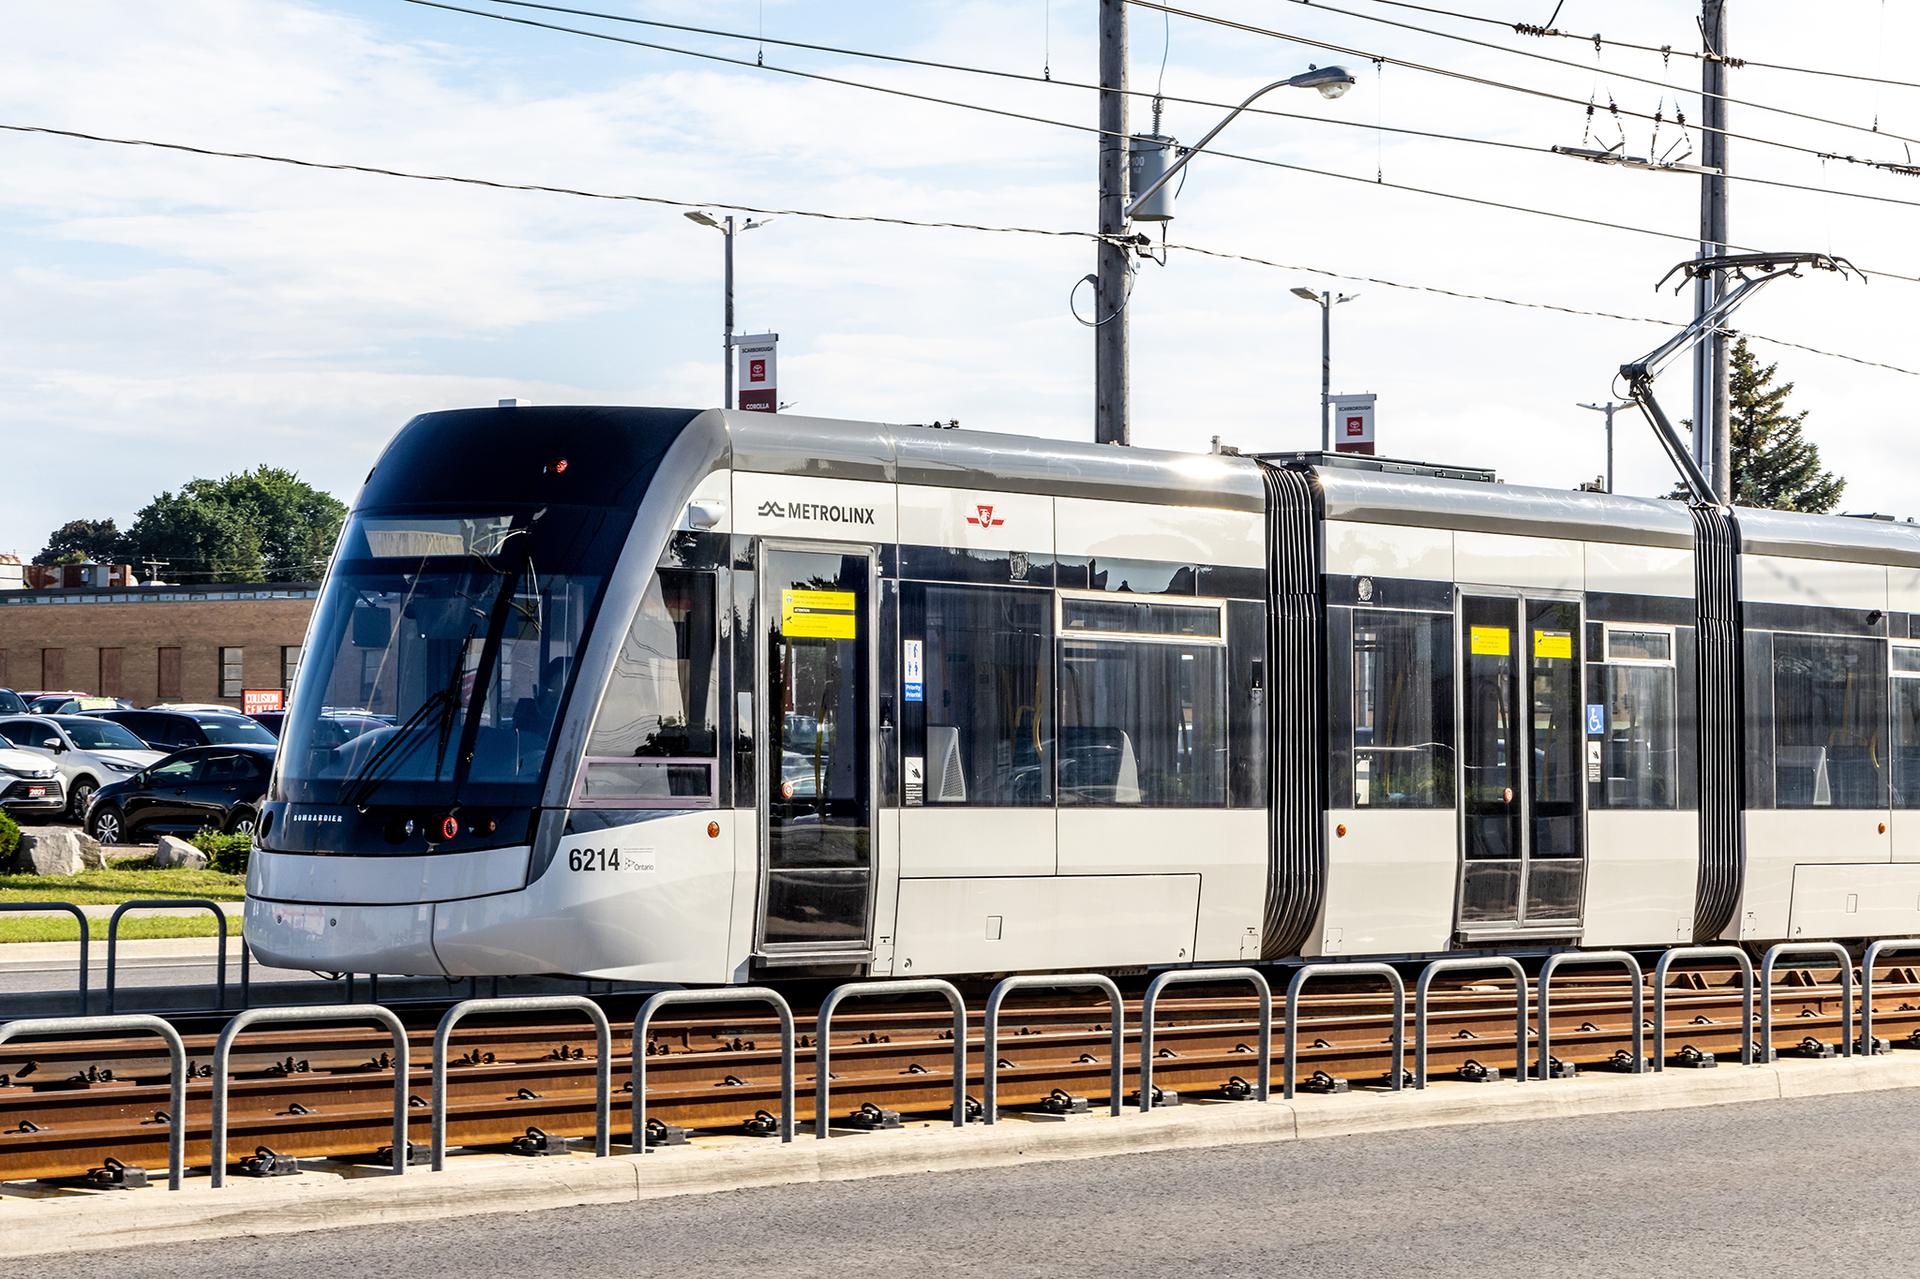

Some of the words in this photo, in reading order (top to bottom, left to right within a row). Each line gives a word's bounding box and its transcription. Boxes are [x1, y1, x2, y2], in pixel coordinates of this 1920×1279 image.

[788, 502, 875, 525] METROLINX
[905, 684, 922, 692] Priority
[246, 693, 279, 703] COLLISION
[29, 788, 46, 797] 2021
[293, 814, 343, 822] BOMBARDIER
[569, 848, 620, 871] 6214
[634, 863, 655, 871] Ontario
